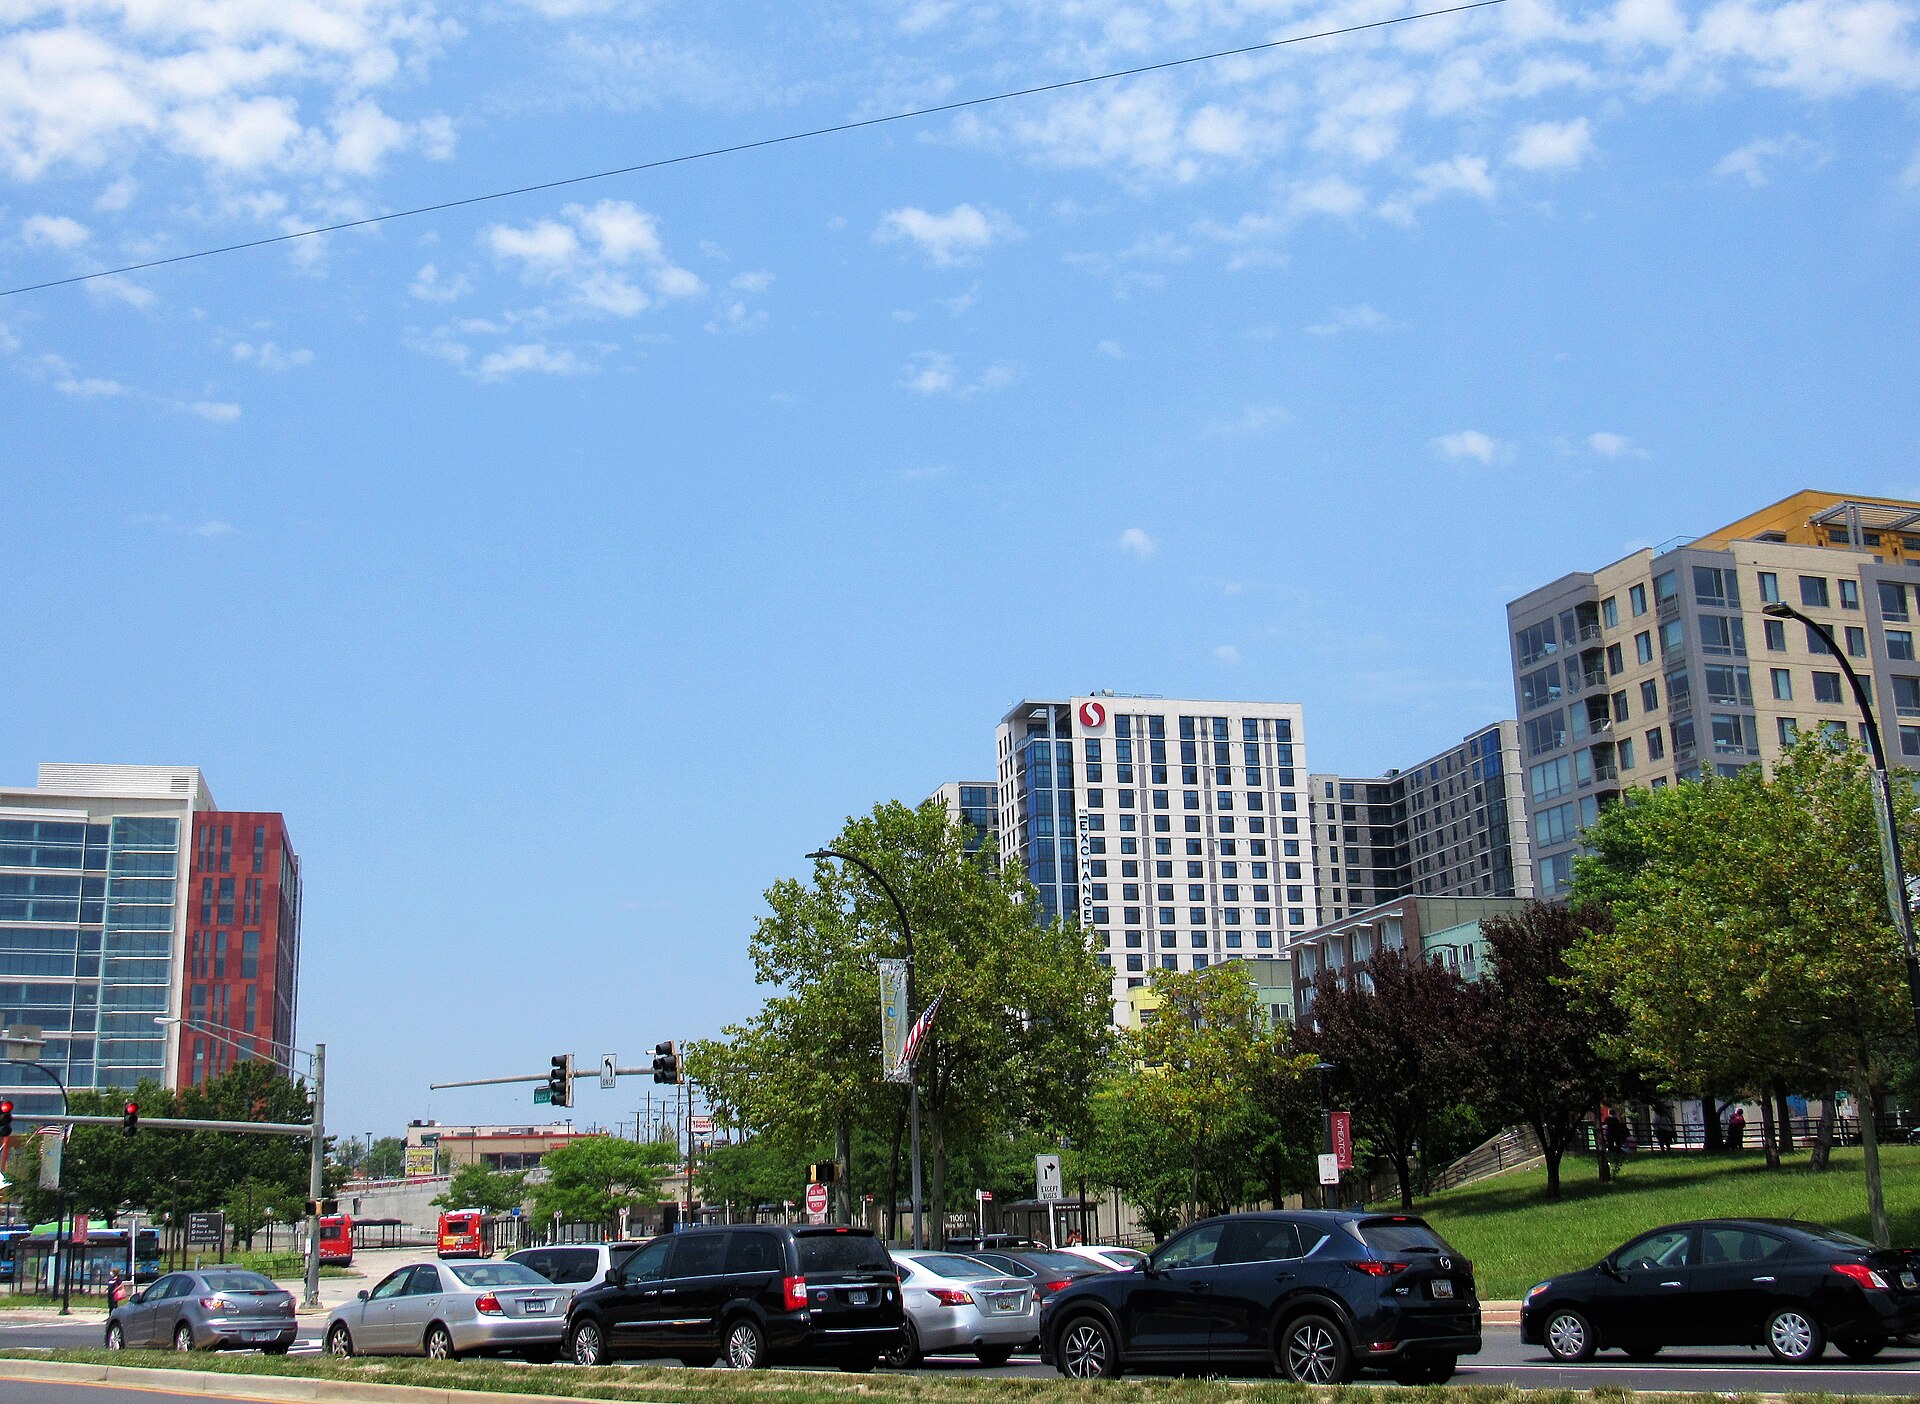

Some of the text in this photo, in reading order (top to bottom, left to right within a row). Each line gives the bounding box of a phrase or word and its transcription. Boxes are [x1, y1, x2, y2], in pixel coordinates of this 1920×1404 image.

[1079, 820, 1092, 919] EXCHANGE
[882, 974, 897, 1069] WHEATON
[1337, 1118, 1346, 1163] WHEATON
[1041, 1185, 1058, 1193] EXCEPT
[1042, 1192, 1058, 1200] BUSES
[949, 1214, 967, 1222] 11001
